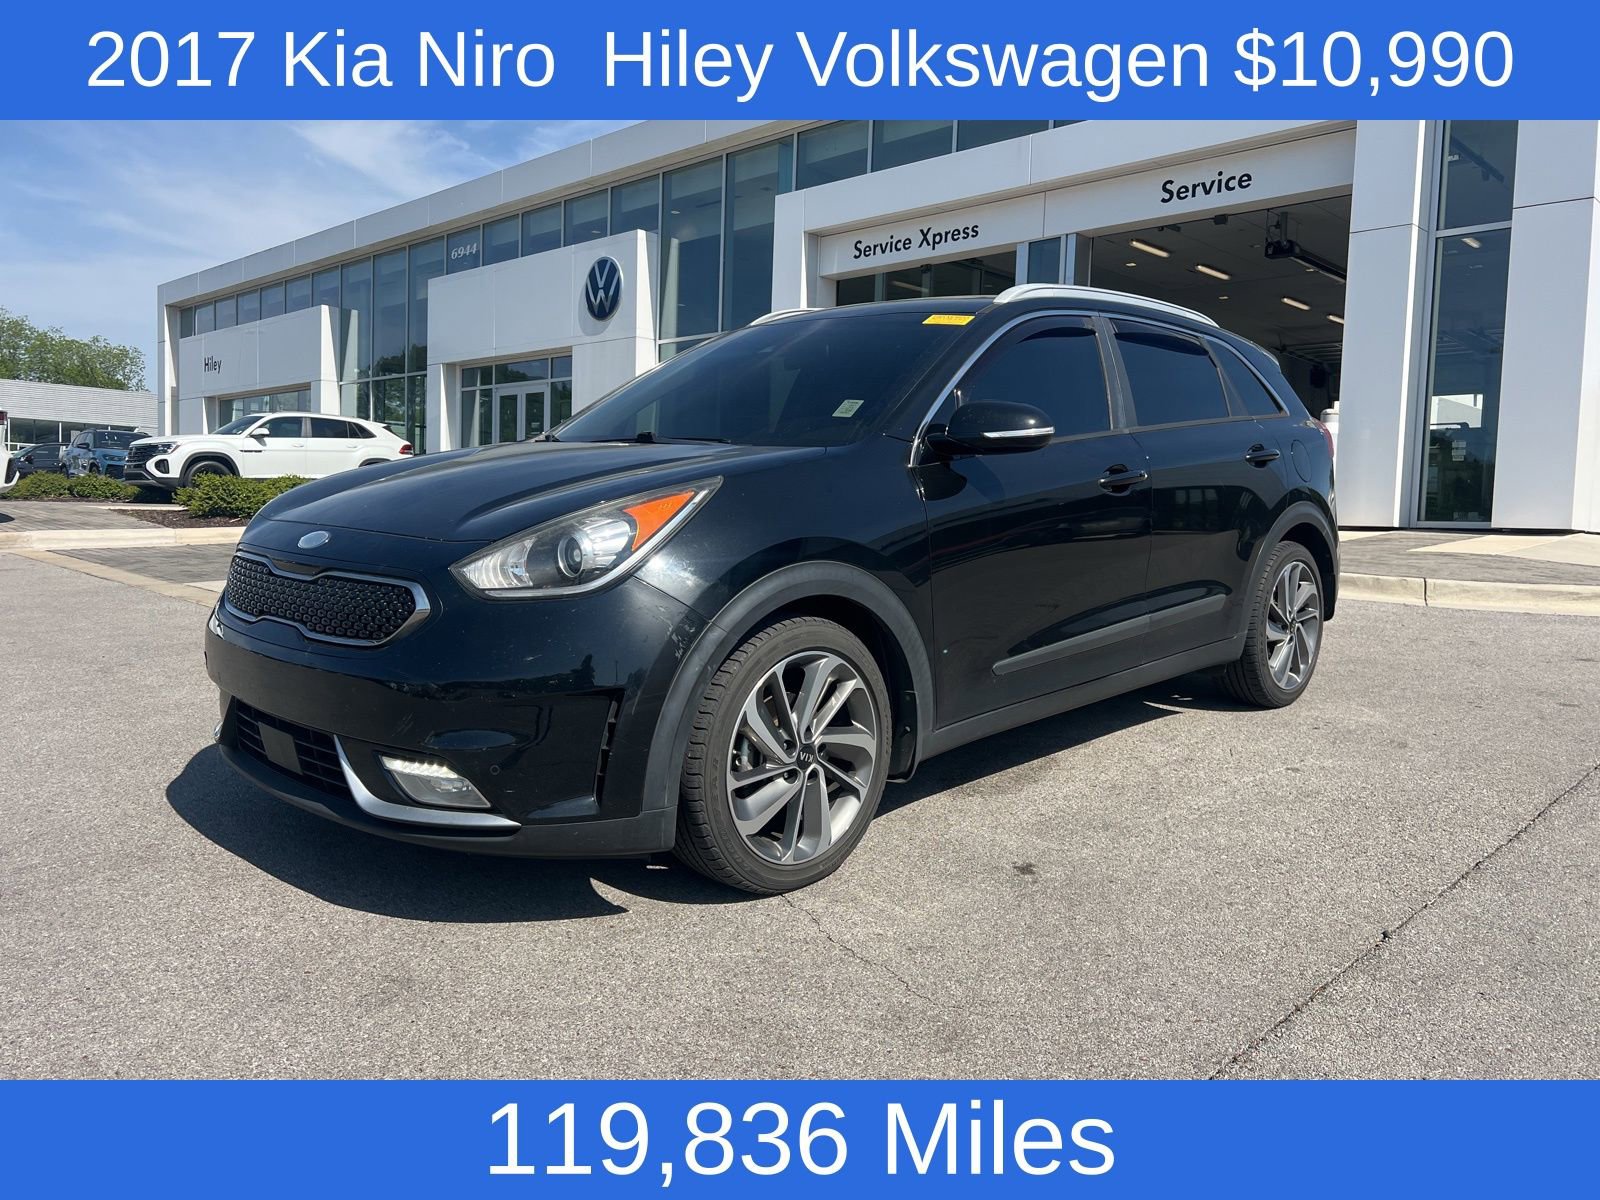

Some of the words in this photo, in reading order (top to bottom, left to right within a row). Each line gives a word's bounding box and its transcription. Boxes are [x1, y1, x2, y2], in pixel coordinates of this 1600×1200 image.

[1160, 170, 1253, 204] Service
[450, 242, 479, 260] 6944
[852, 234, 913, 260] Service
[917, 224, 980, 251] Xpress
[203, 355, 222, 375] Hiley
